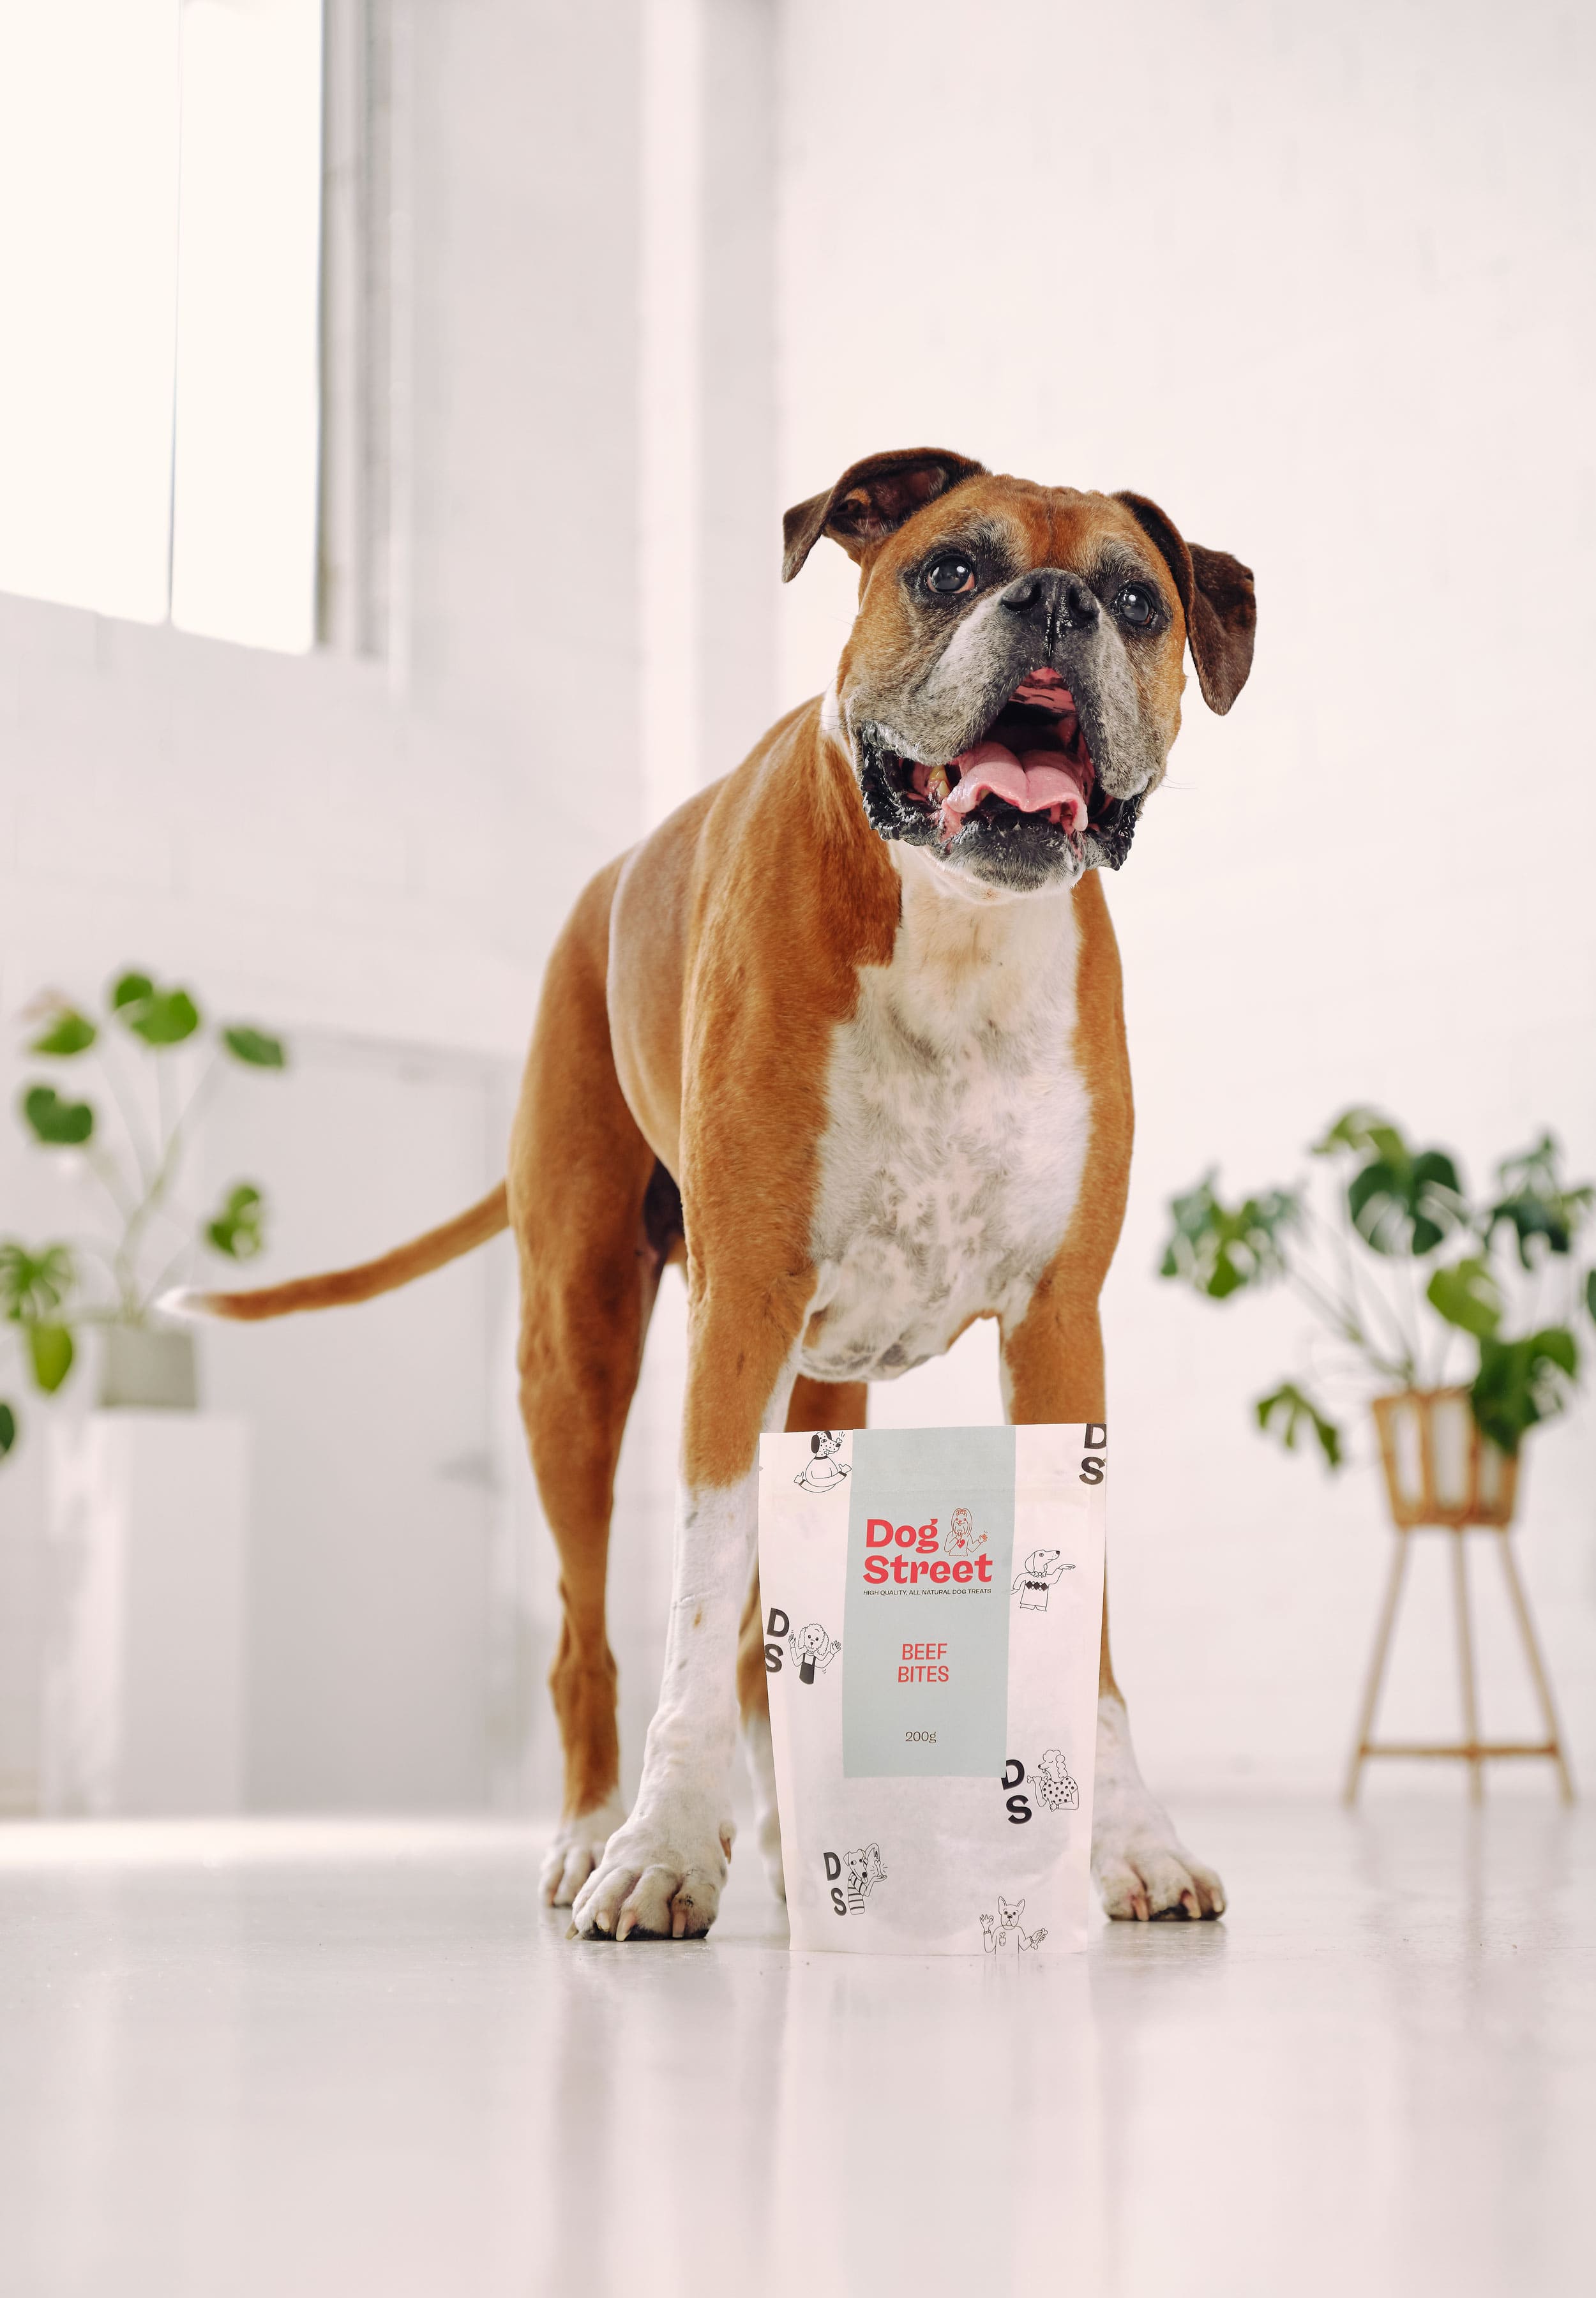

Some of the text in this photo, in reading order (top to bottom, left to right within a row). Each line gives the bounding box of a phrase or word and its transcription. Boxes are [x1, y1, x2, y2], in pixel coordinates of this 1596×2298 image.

[1084, 1423, 1107, 1450] D
[1079, 1457, 1105, 1485] S
[866, 1519, 939, 1554] Dog
[863, 1553, 993, 1584] Street
[767, 1607, 790, 1637] D
[764, 1643, 784, 1673] S
[901, 1642, 948, 1660] BEEF
[898, 1665, 949, 1683] BITES
[905, 1731, 937, 1744] 200g
[1000, 1759, 1025, 1791] D
[1005, 1794, 1032, 1824] S
[823, 1852, 841, 1881] D
[830, 1888, 847, 1916] S
